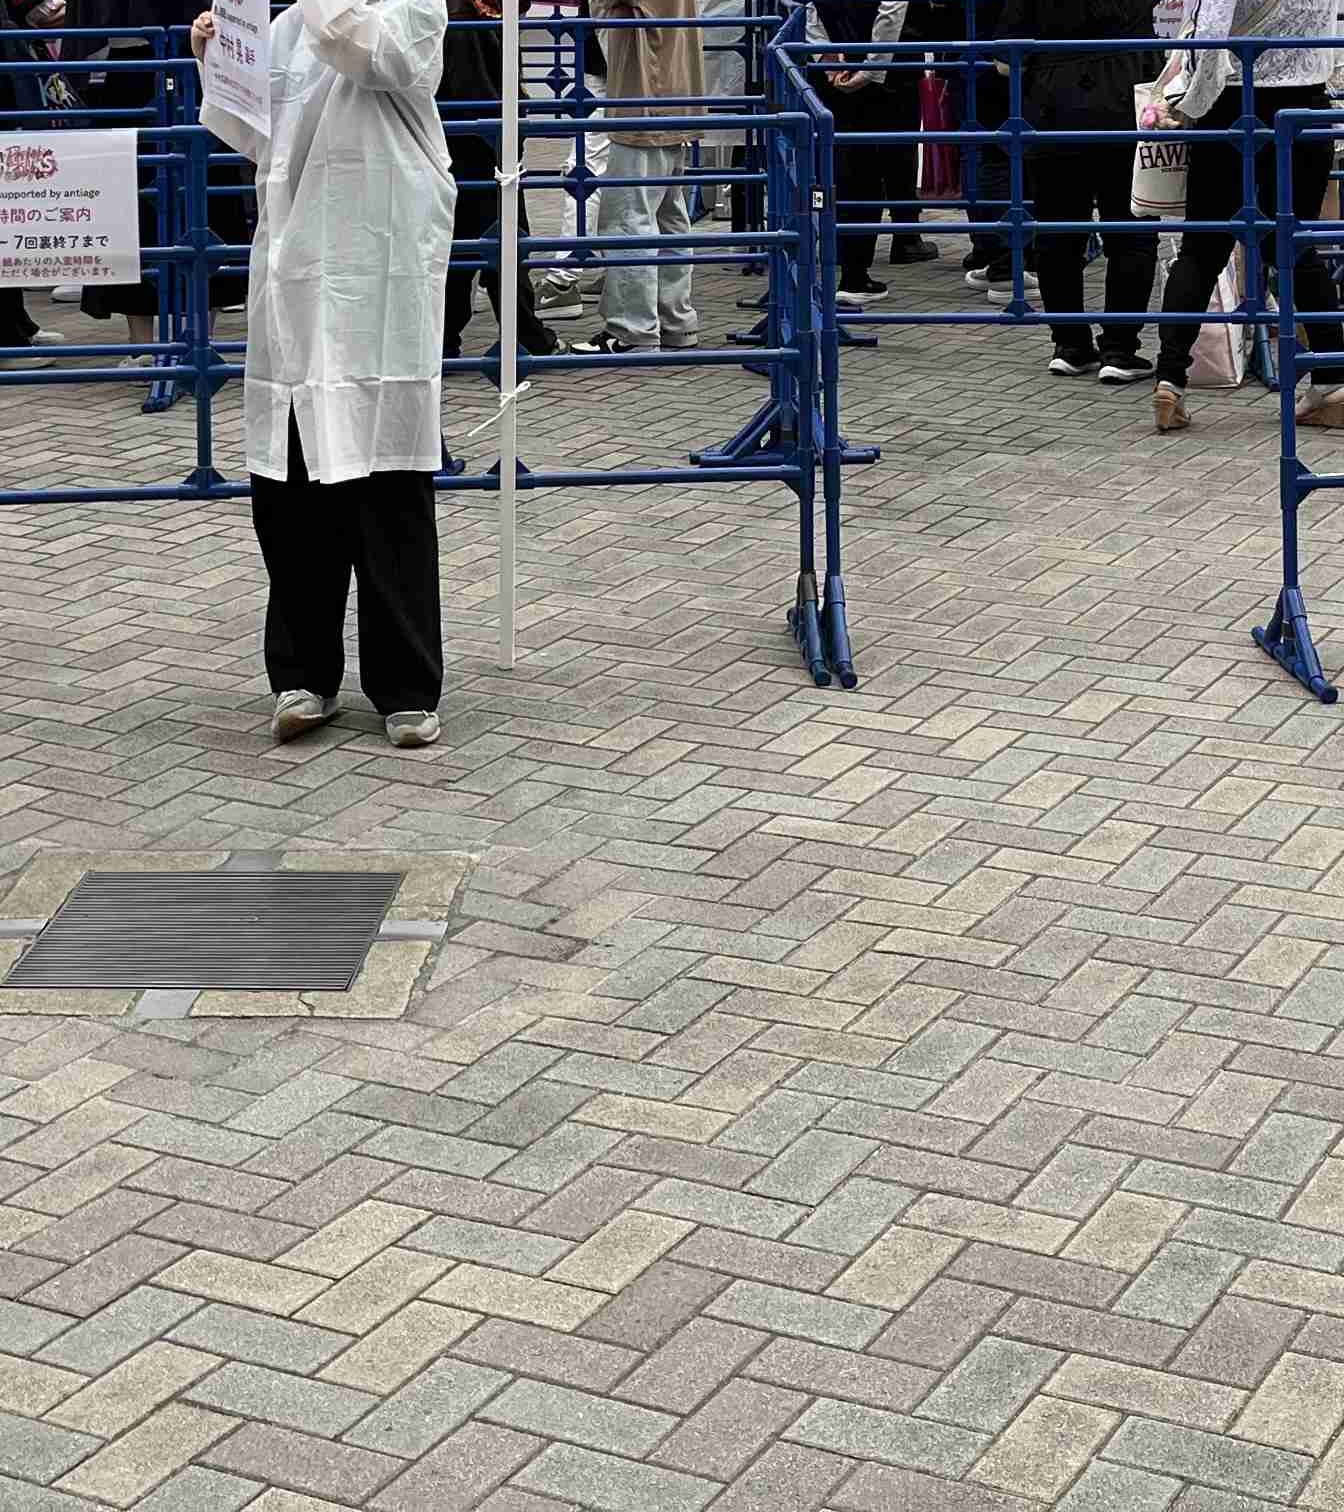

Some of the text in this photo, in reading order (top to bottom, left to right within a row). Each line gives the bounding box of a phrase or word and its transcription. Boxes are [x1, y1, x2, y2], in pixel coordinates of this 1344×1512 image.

[1139, 143, 1188, 169] HAW
[50, 188, 61, 200] by
[63, 188, 100, 199] antiage
